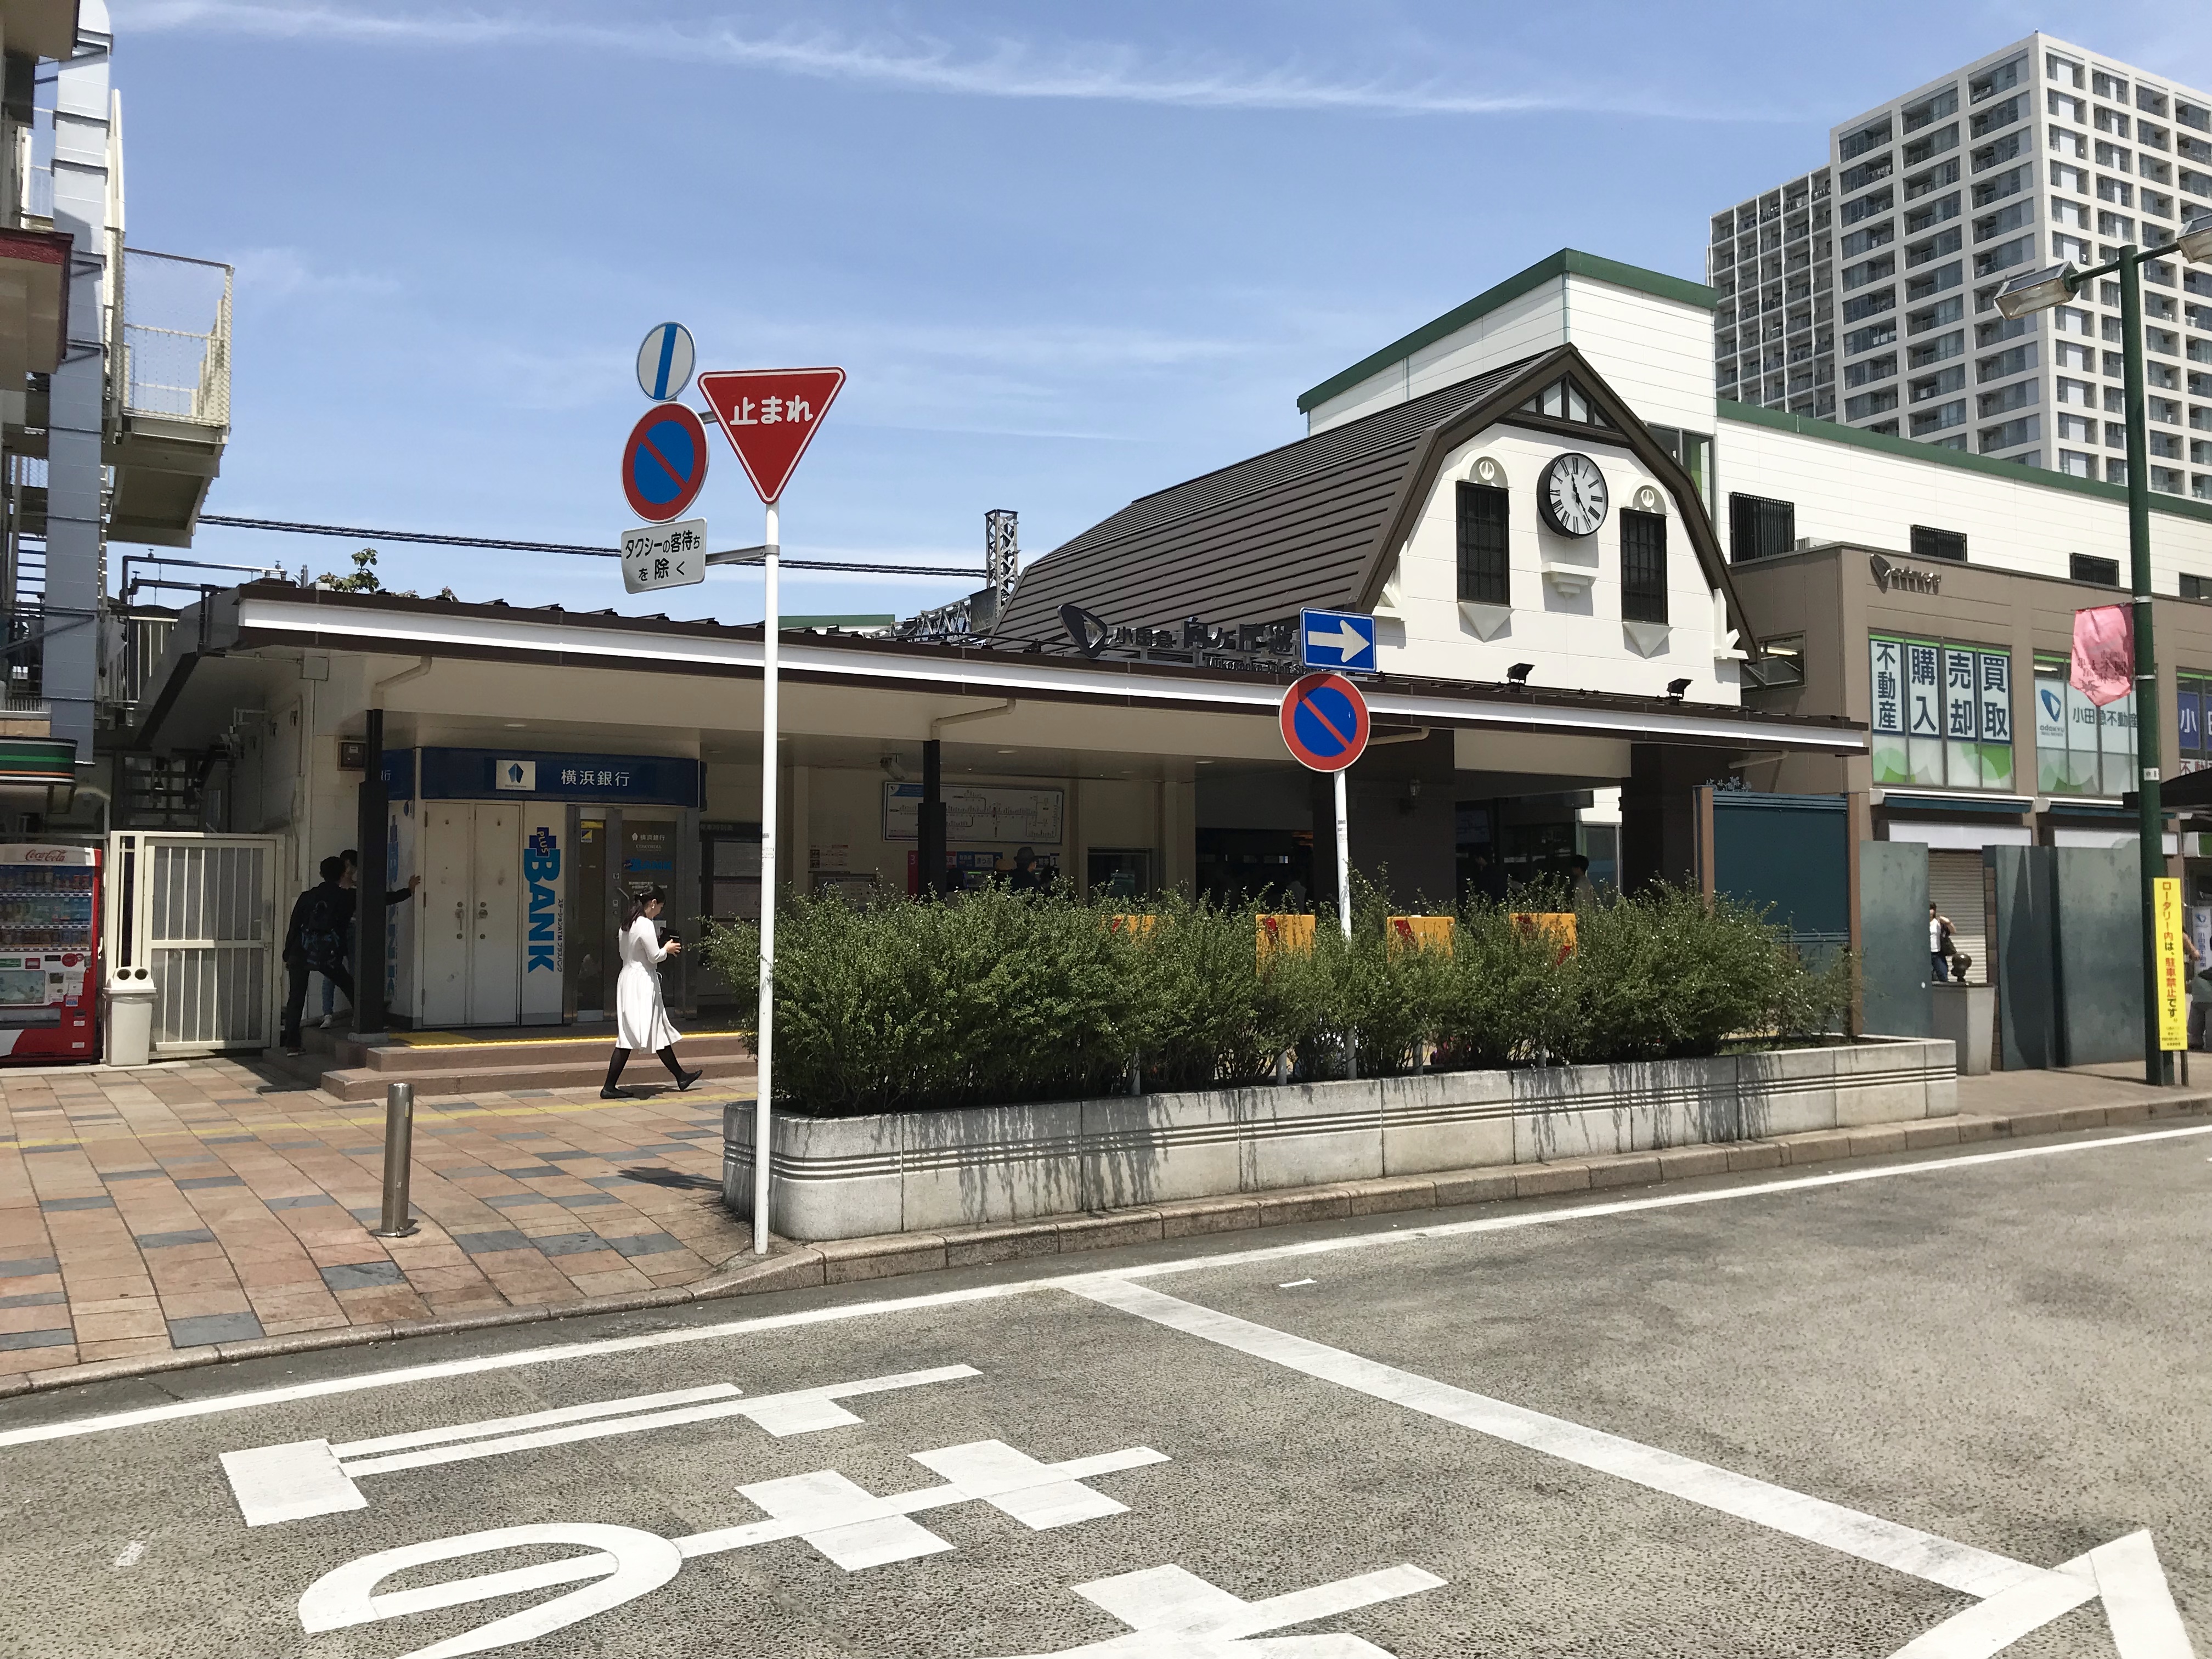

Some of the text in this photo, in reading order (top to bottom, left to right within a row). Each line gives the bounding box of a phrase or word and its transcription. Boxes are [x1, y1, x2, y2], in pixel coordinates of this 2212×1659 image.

[730, 394, 814, 425] 止まれ
[625, 529, 701, 560] タクシーの客待ち
[639, 558, 686, 582] を除く
[1876, 643, 2008, 738] 不動産 購入 売却 買取
[2073, 707, 2138, 728] 小田急不動産
[561, 769, 630, 787] 横浜銀行
[537, 827, 549, 854] PLUS
[910, 855, 916, 865] 3
[524, 849, 561, 974] BANK
